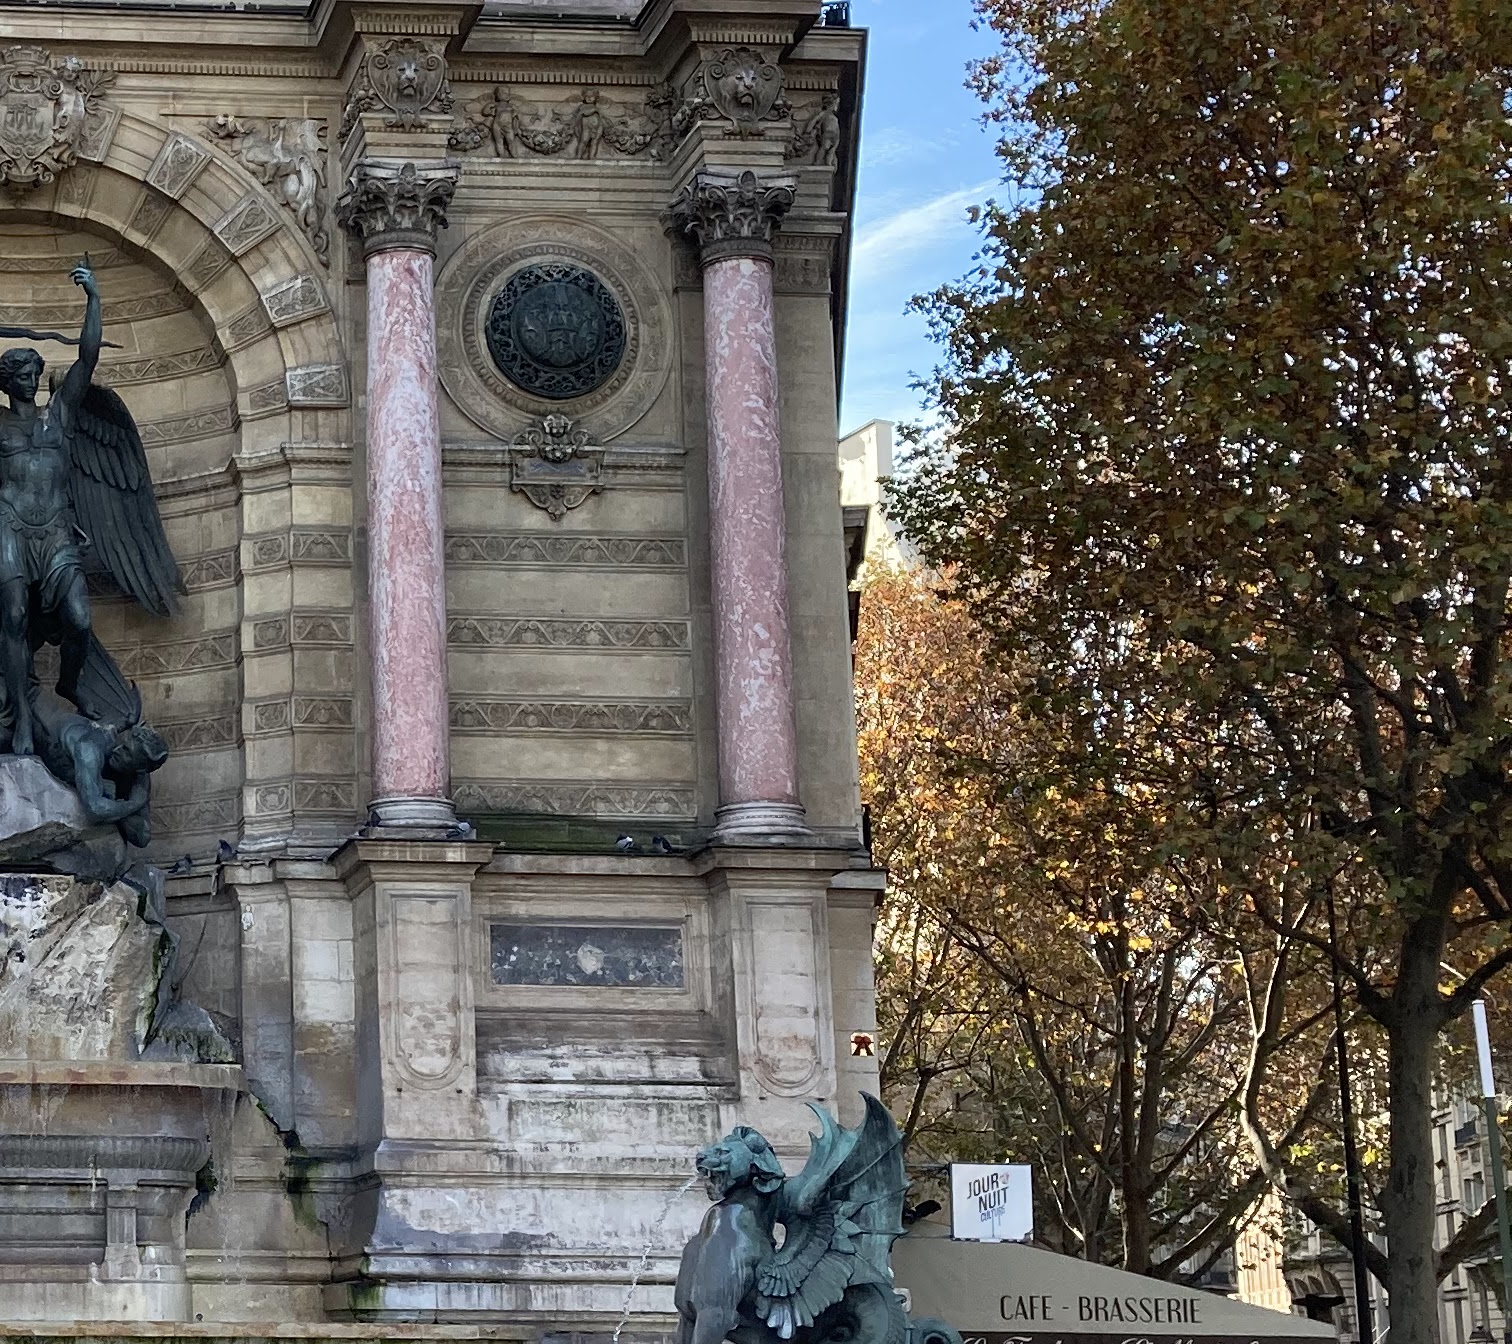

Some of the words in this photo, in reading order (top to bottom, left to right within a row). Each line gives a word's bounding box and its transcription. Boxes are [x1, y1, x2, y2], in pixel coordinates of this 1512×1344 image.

[967, 1172, 999, 1199] JOUR
[978, 1186, 1009, 1213] NUIT
[999, 1295, 1054, 1321] CAFE
[1078, 1295, 1203, 1324] BRASSERIE
